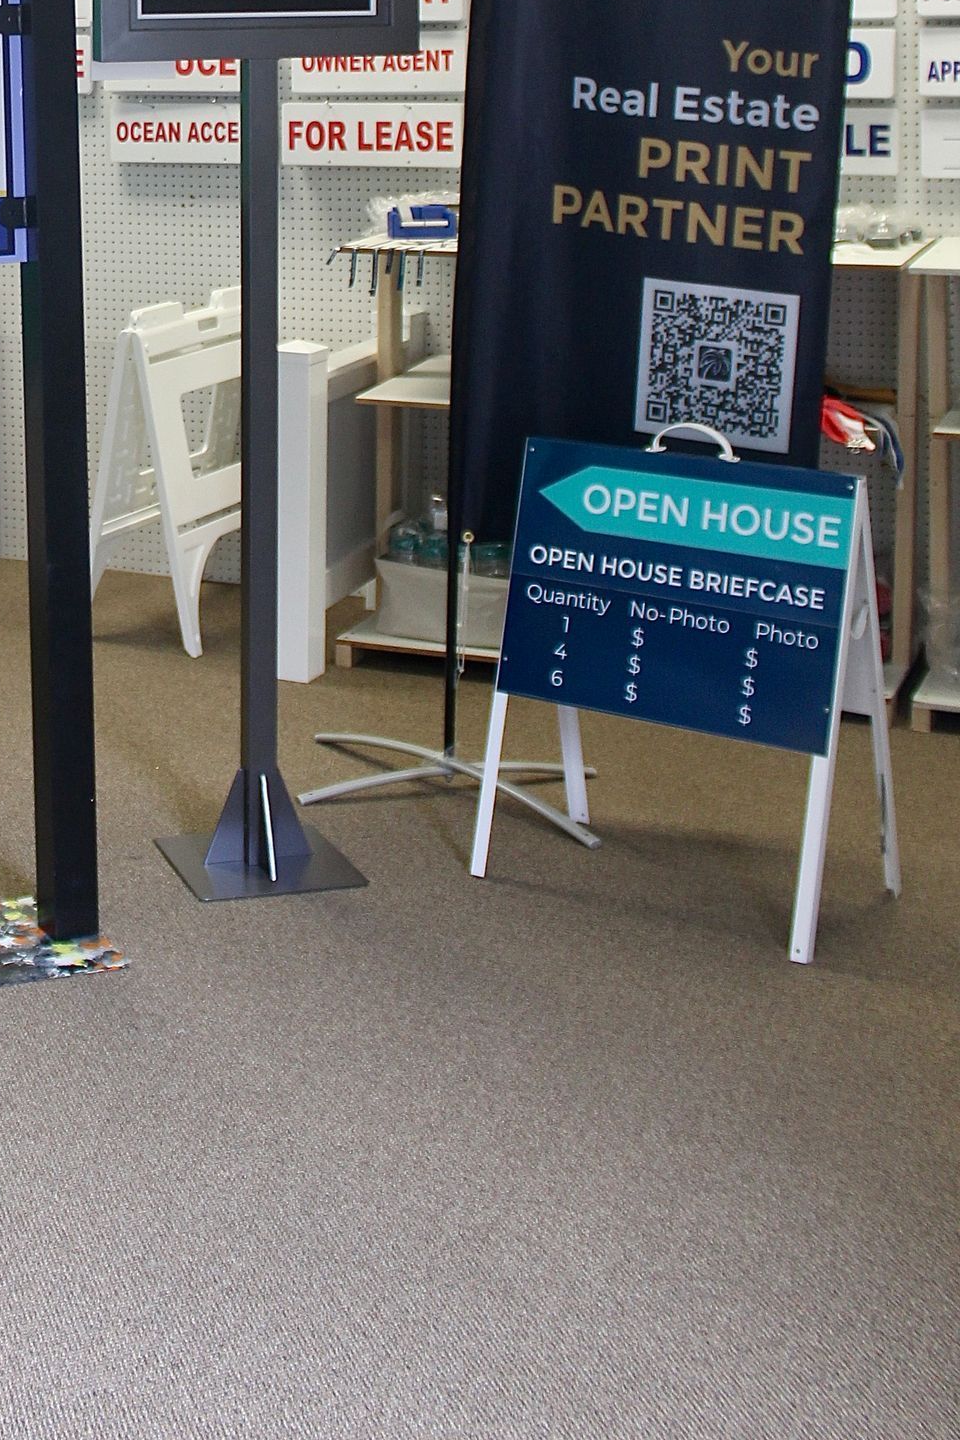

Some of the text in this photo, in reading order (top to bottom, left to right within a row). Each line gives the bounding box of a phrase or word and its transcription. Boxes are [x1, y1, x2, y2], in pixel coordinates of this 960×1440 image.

[301, 50, 453, 72] OWNER AGENT
[722, 40, 819, 78] Your
[573, 76, 819, 131] Real Estate
[117, 122, 239, 143] OCEAN ACCE
[289, 121, 454, 152] FOR LEASE
[639, 137, 812, 193] PRINT
[553, 185, 804, 254] PARTNER
[583, 485, 841, 549] OPEN HOUSE
[530, 545, 825, 610] OPEN HOUSE BRIEFCASE
[527, 584, 611, 617] Quantity
[755, 622, 819, 650] Photo
[562, 617, 758, 669] 1 $ $
[551, 670, 751, 725] 6 $ $
[554, 644, 755, 697] 4 $ $
